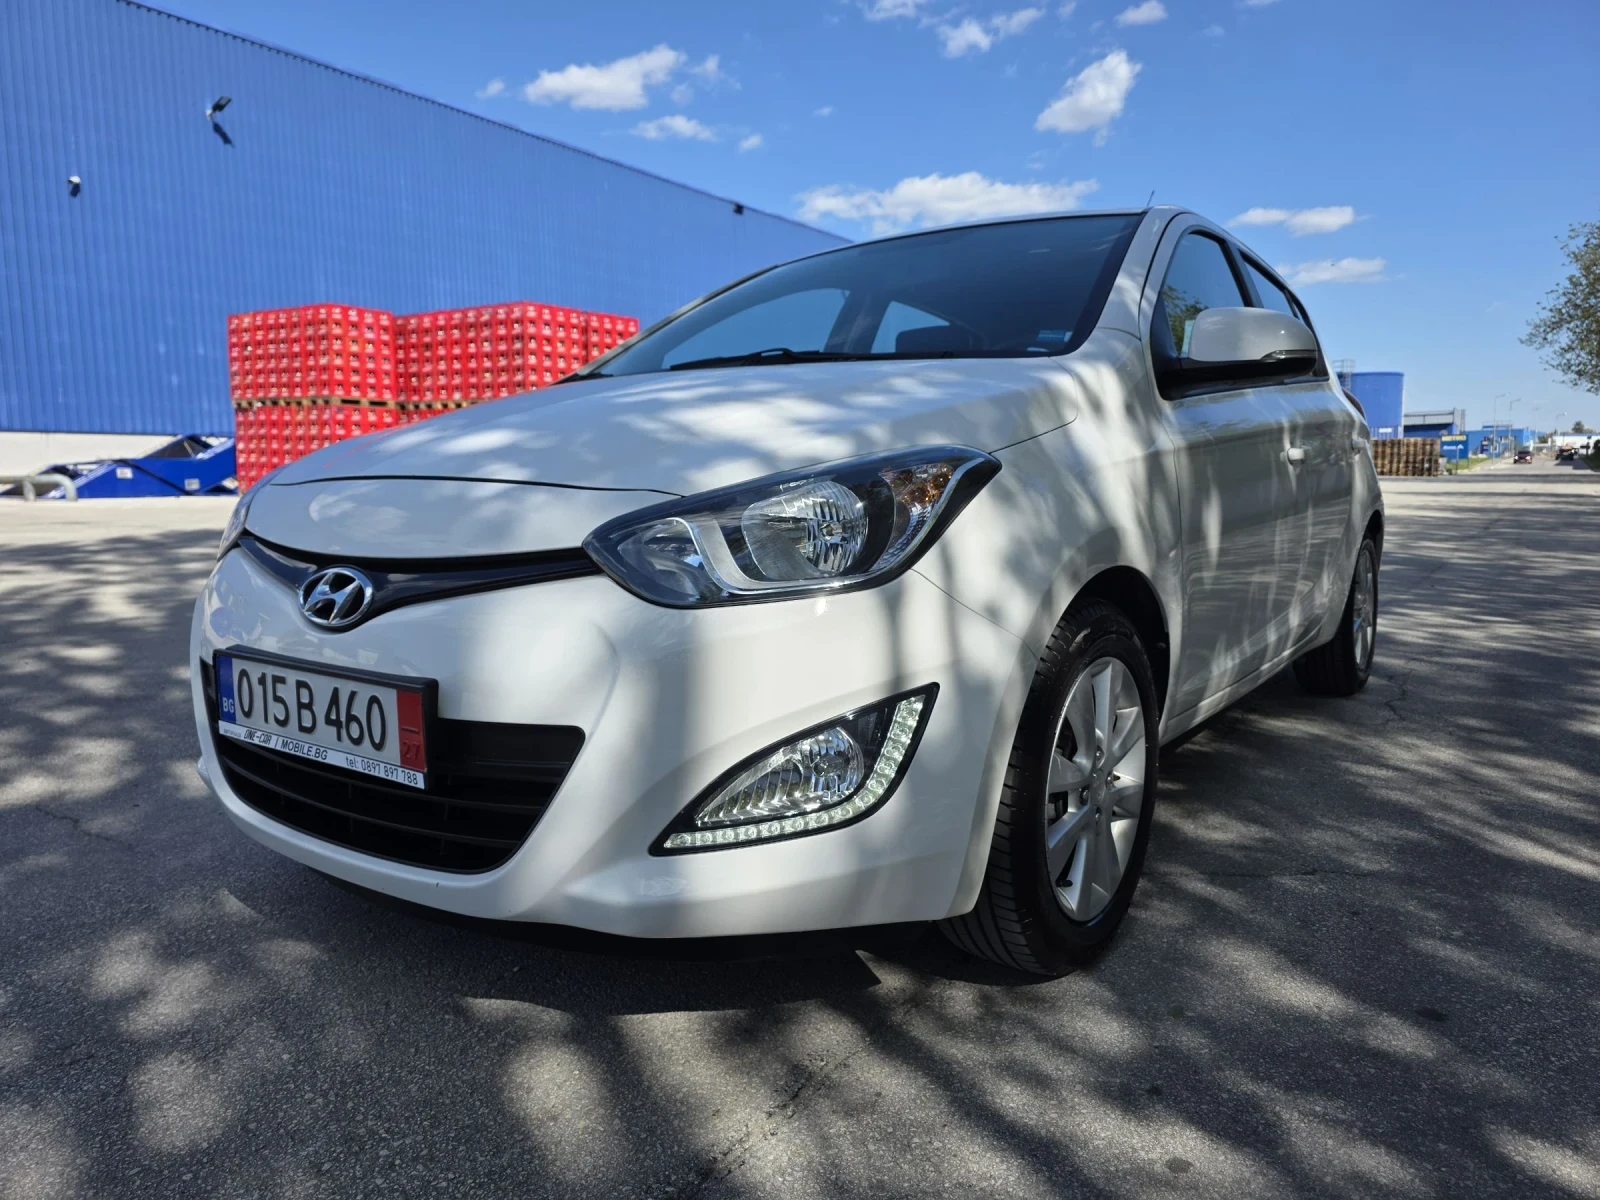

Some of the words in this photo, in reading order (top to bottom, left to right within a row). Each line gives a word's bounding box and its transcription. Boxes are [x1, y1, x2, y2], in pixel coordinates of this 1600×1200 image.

[222, 697, 235, 713] BG
[243, 729, 273, 746] ONE-CAR
[280, 738, 328, 761] MOBILE.BG
[402, 740, 420, 761] 27
[360, 759, 381, 776] 0897
[383, 765, 399, 780] 897
[401, 770, 418, 785] 788
